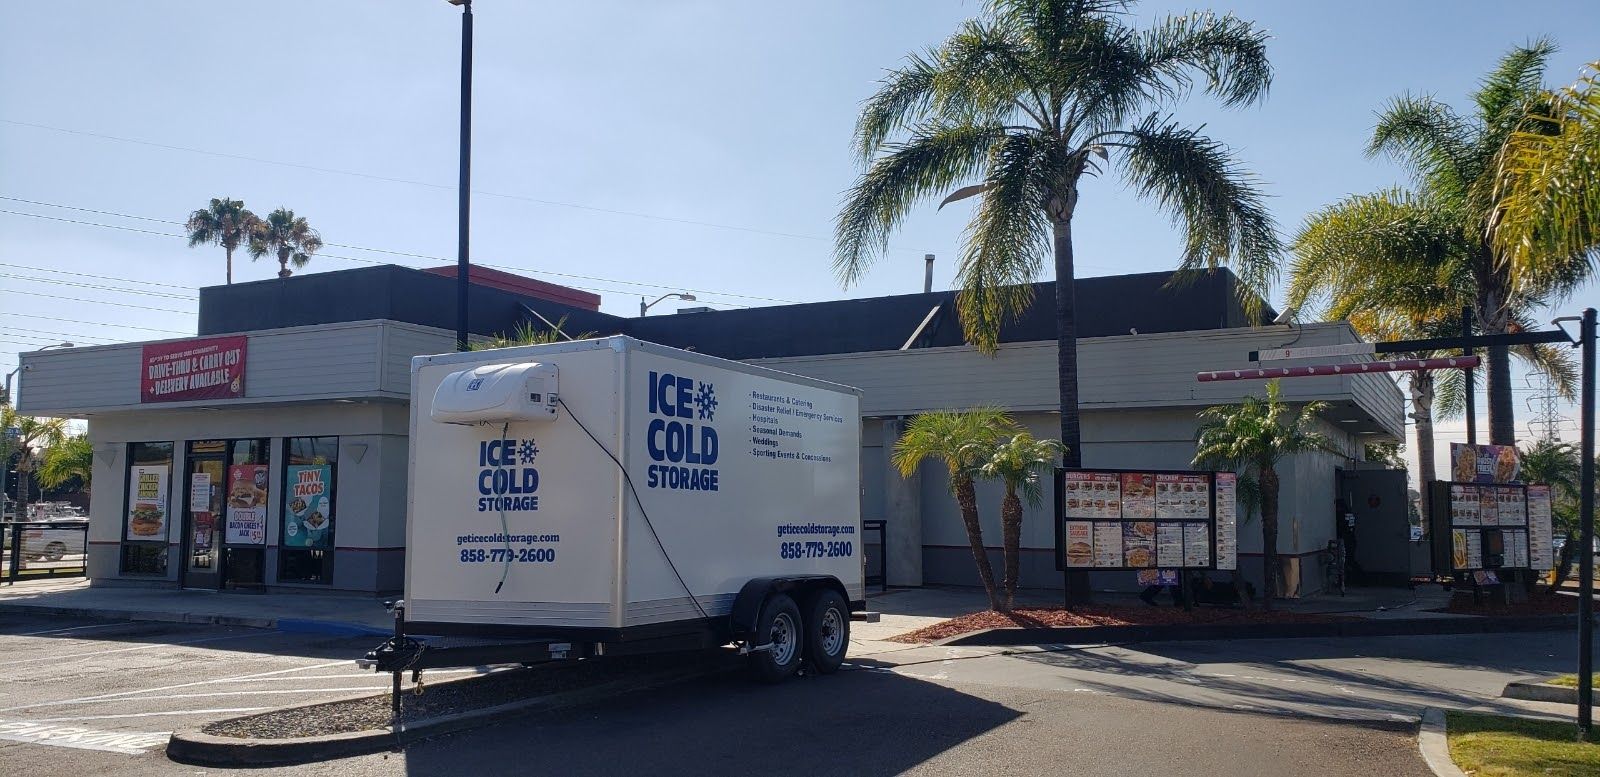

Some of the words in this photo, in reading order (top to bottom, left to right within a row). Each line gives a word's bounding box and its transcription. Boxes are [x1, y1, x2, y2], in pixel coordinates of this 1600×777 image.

[149, 359, 191, 379] DRIVE-THRU
[192, 357, 199, 371] &
[200, 352, 224, 370] CARRY
[224, 348, 240, 365] OUT
[155, 376, 189, 395] DELIVERY
[189, 368, 230, 389] AVAILABLE
[649, 371, 694, 419] ICE
[752, 391, 785, 403] Restaurants
[791, 398, 813, 409] Catering
[752, 402, 776, 413] Disaster
[776, 406, 792, 416] Relief
[796, 409, 823, 421] Emergency
[823, 413, 843, 423] Services
[752, 414, 779, 424] Hospitals
[752, 425, 778, 435] Seasonal
[778, 428, 802, 439] Demands
[647, 418, 719, 465] COLD
[752, 436, 779, 447] Weddings
[480, 440, 517, 467] ICE
[752, 448, 777, 459] Sporting
[777, 450, 795, 459] Events
[801, 453, 831, 462] Concessions
[478, 467, 539, 496] COLD
[647, 464, 719, 491] STORAGE
[294, 481, 325, 497] TACOS
[478, 496, 538, 512] STORAGE
[234, 511, 256, 521] DOUBLE
[229, 521, 243, 529] BACON
[239, 529, 249, 537] JACK
[777, 522, 855, 538] geticecoldstorage.com
[460, 548, 555, 563] 858-779-2600
[781, 541, 853, 559] 858-779-2600
